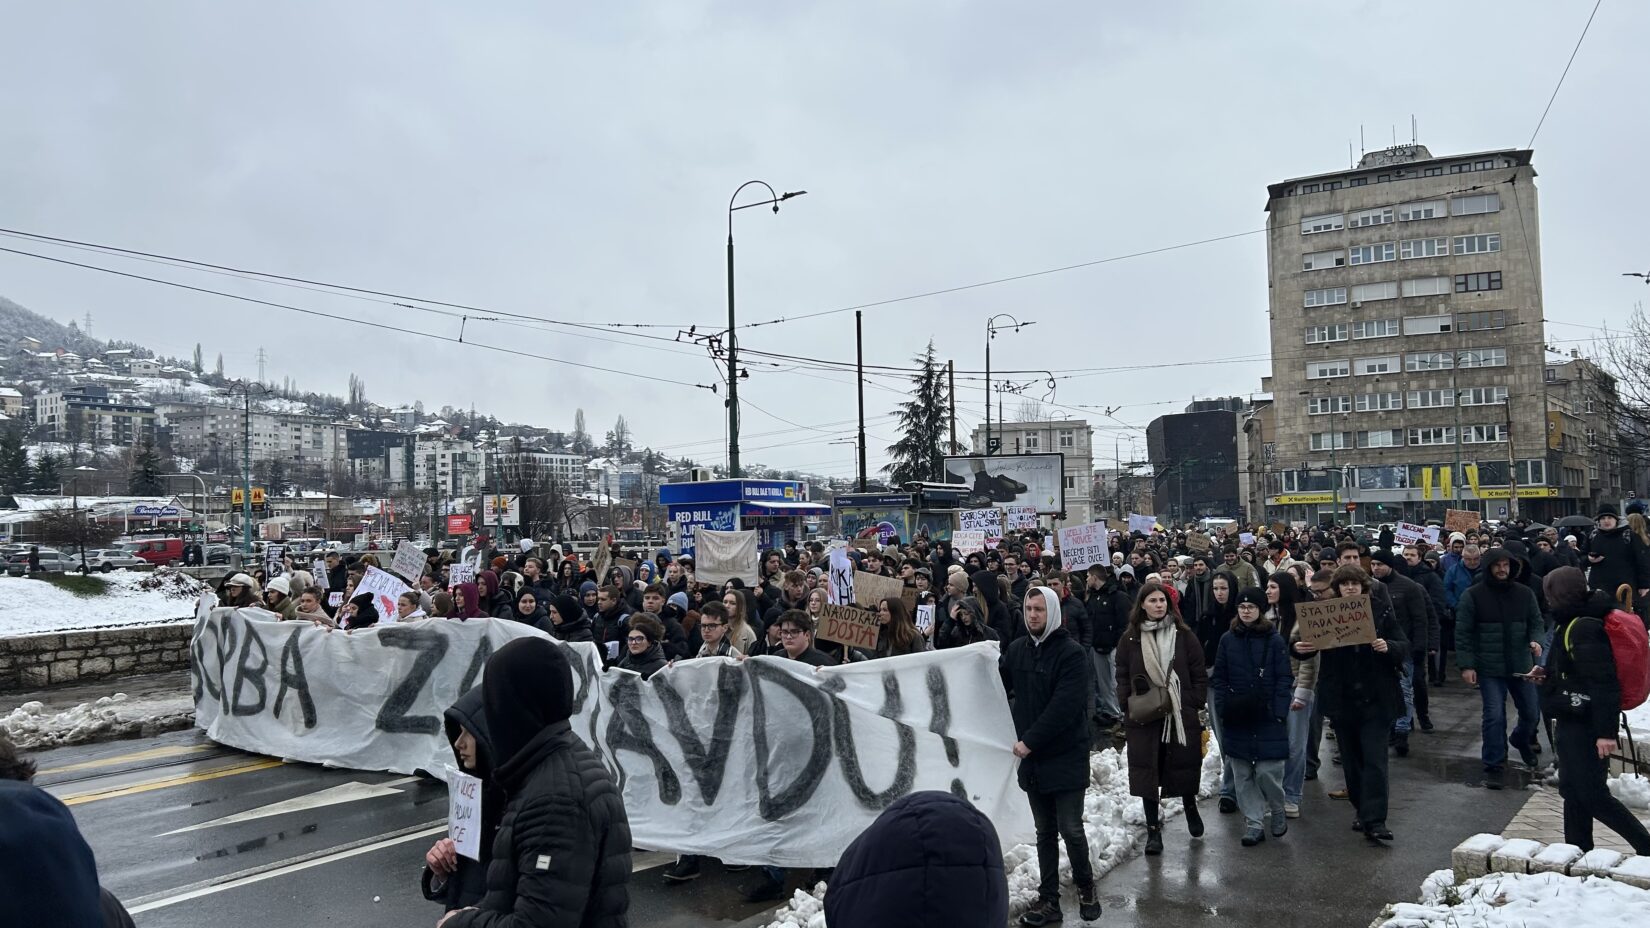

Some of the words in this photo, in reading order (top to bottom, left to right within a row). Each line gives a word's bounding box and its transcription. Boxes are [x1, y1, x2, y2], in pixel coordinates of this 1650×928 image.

[676, 511, 692, 523] RED
[693, 510, 713, 522] BULL
[1085, 525, 1097, 534] STE
[822, 603, 858, 621] NAROD
[1300, 606, 1323, 619] ŠTA
[1325, 604, 1336, 614] TO
[1339, 597, 1367, 612] PADA?
[1307, 618, 1333, 630] PADA
[1333, 611, 1369, 625] VLADA
[827, 618, 876, 647] DOSTA
